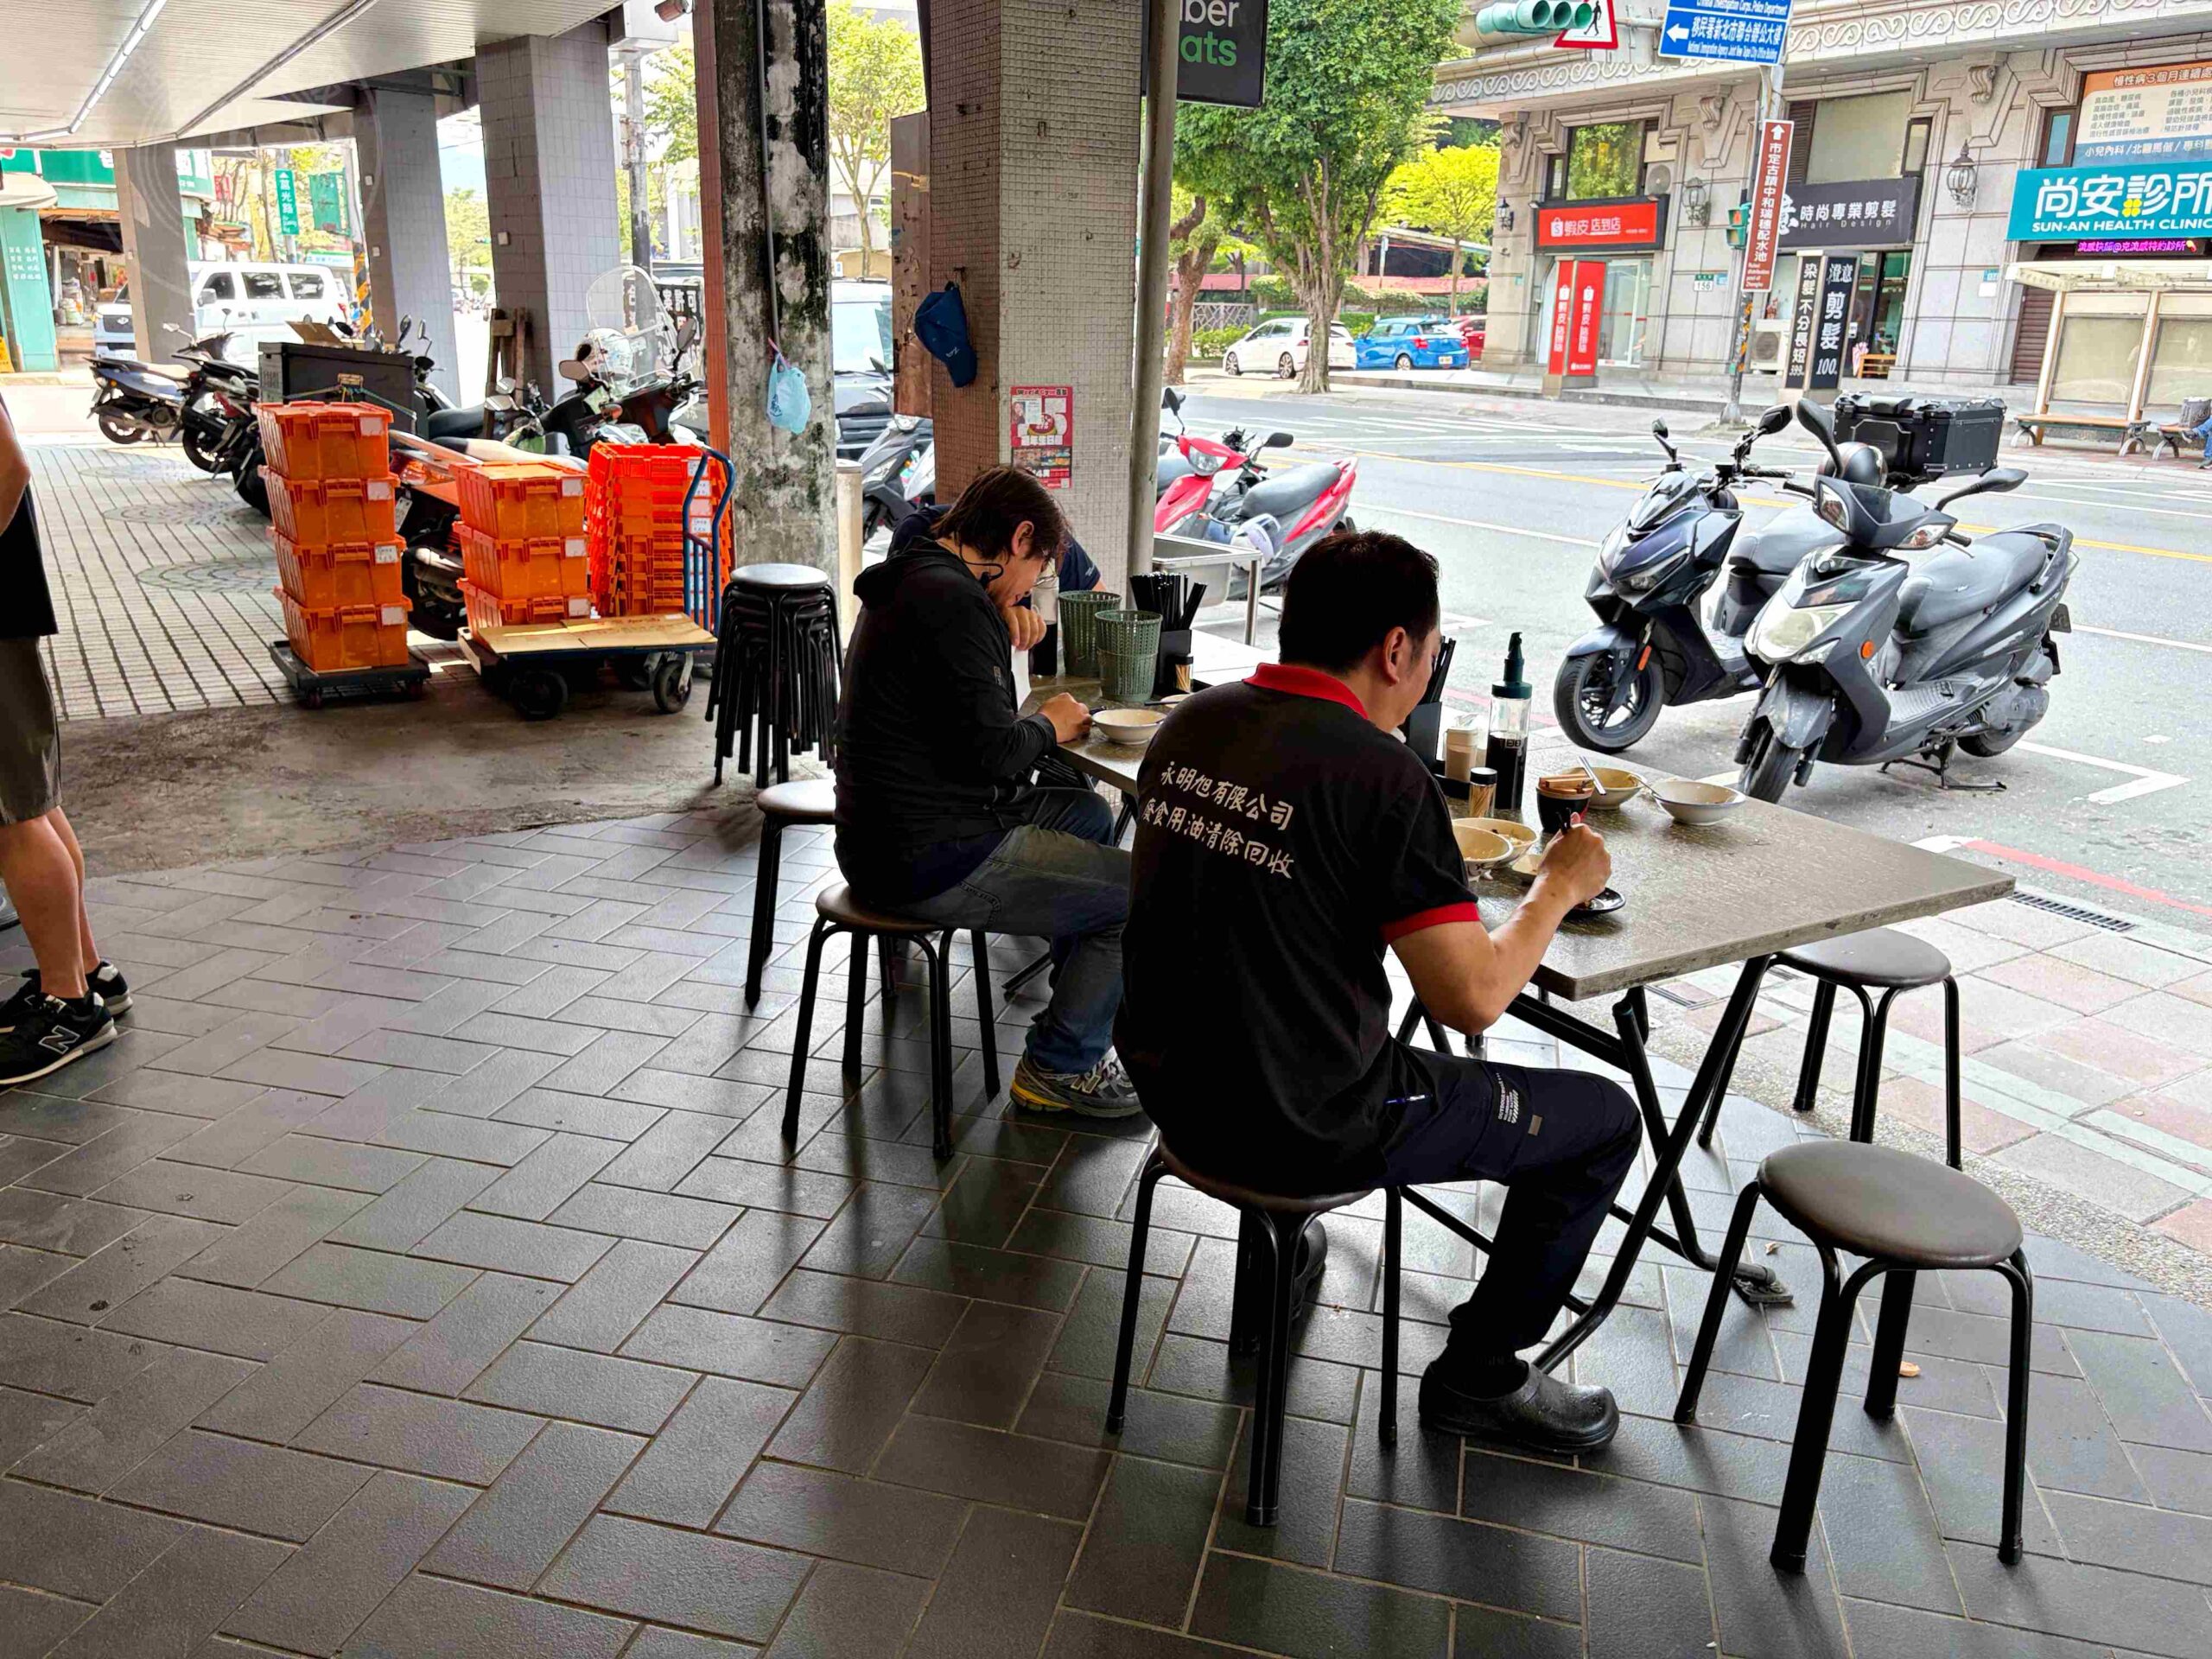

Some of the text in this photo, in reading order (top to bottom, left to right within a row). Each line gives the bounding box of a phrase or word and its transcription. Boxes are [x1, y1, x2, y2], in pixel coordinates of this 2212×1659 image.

[1179, 0, 1240, 28] ber
[1800, 200, 1897, 221] 時尚專業剪髮
[2034, 173, 2212, 219] 尚安診所
[1840, 219, 1891, 230] Design
[2032, 219, 2212, 232] SUN-AN HEALTH CLINIC
[1792, 263, 1818, 364] 染髮不分長短
[1820, 291, 1847, 350] 剪髮
[1160, 761, 1294, 830] 永明旭有限公司
[1141, 798, 1294, 879] 廢食用油清除回收
